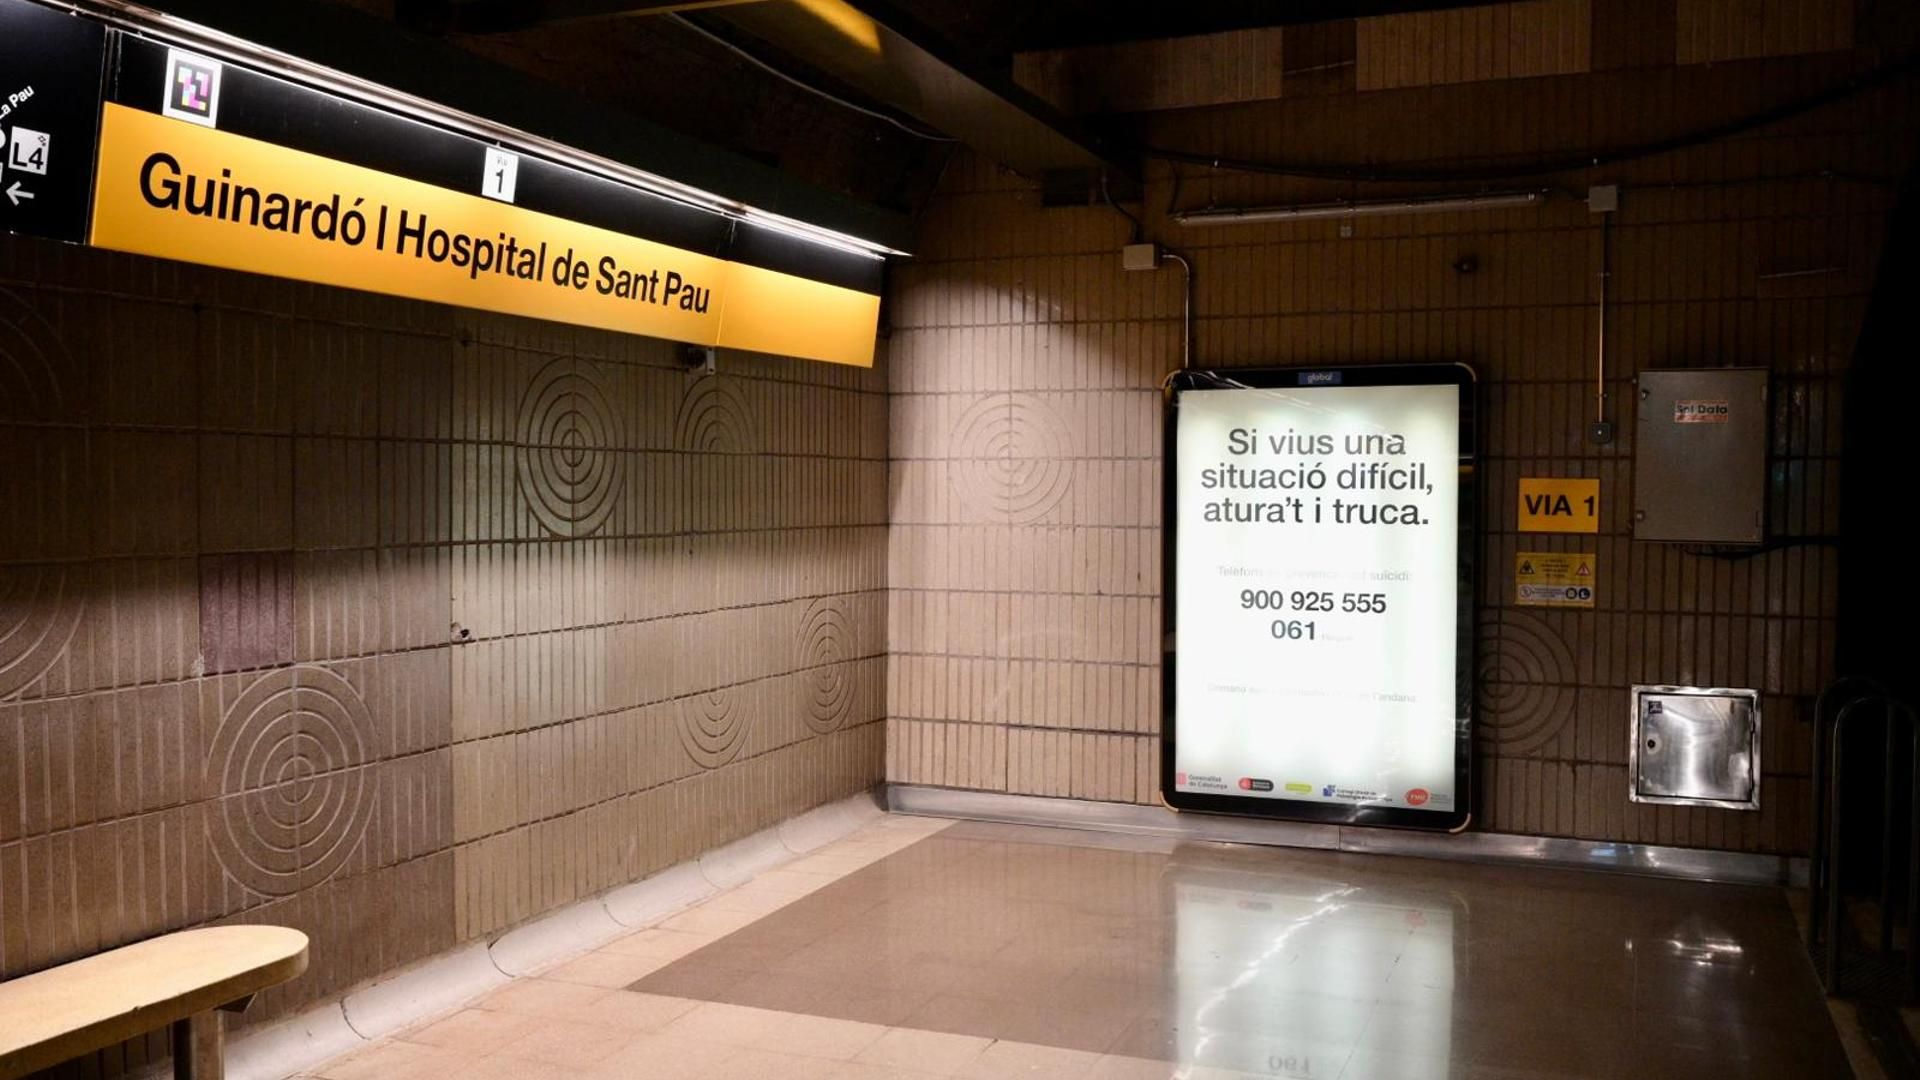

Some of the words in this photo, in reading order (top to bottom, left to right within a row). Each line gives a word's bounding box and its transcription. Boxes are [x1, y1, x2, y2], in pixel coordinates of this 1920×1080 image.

[9, 85, 35, 108] Pau
[12, 141, 44, 170] L4
[495, 168, 505, 194] 1
[140, 153, 366, 246] Guinardó
[396, 210, 547, 282] Hospital
[552, 248, 590, 290] de
[595, 256, 659, 304] Sant
[663, 271, 710, 314] Pau
[1307, 371, 1332, 385] global
[1698, 404, 1728, 414] Data
[1228, 428, 1257, 455] Si
[1269, 428, 1334, 455] vius
[1345, 434, 1406, 455] una
[1202, 462, 1326, 490] situació
[1337, 462, 1433, 495] difícil,
[1314, 497, 1321, 523] i
[1333, 498, 1429, 526] truca.
[1525, 495, 1573, 516] VIA
[1584, 495, 1595, 517] 1
[1240, 589, 1284, 610] 900
[1290, 591, 1335, 612] 925
[1341, 593, 1387, 614] 555
[1271, 619, 1315, 641] 061
